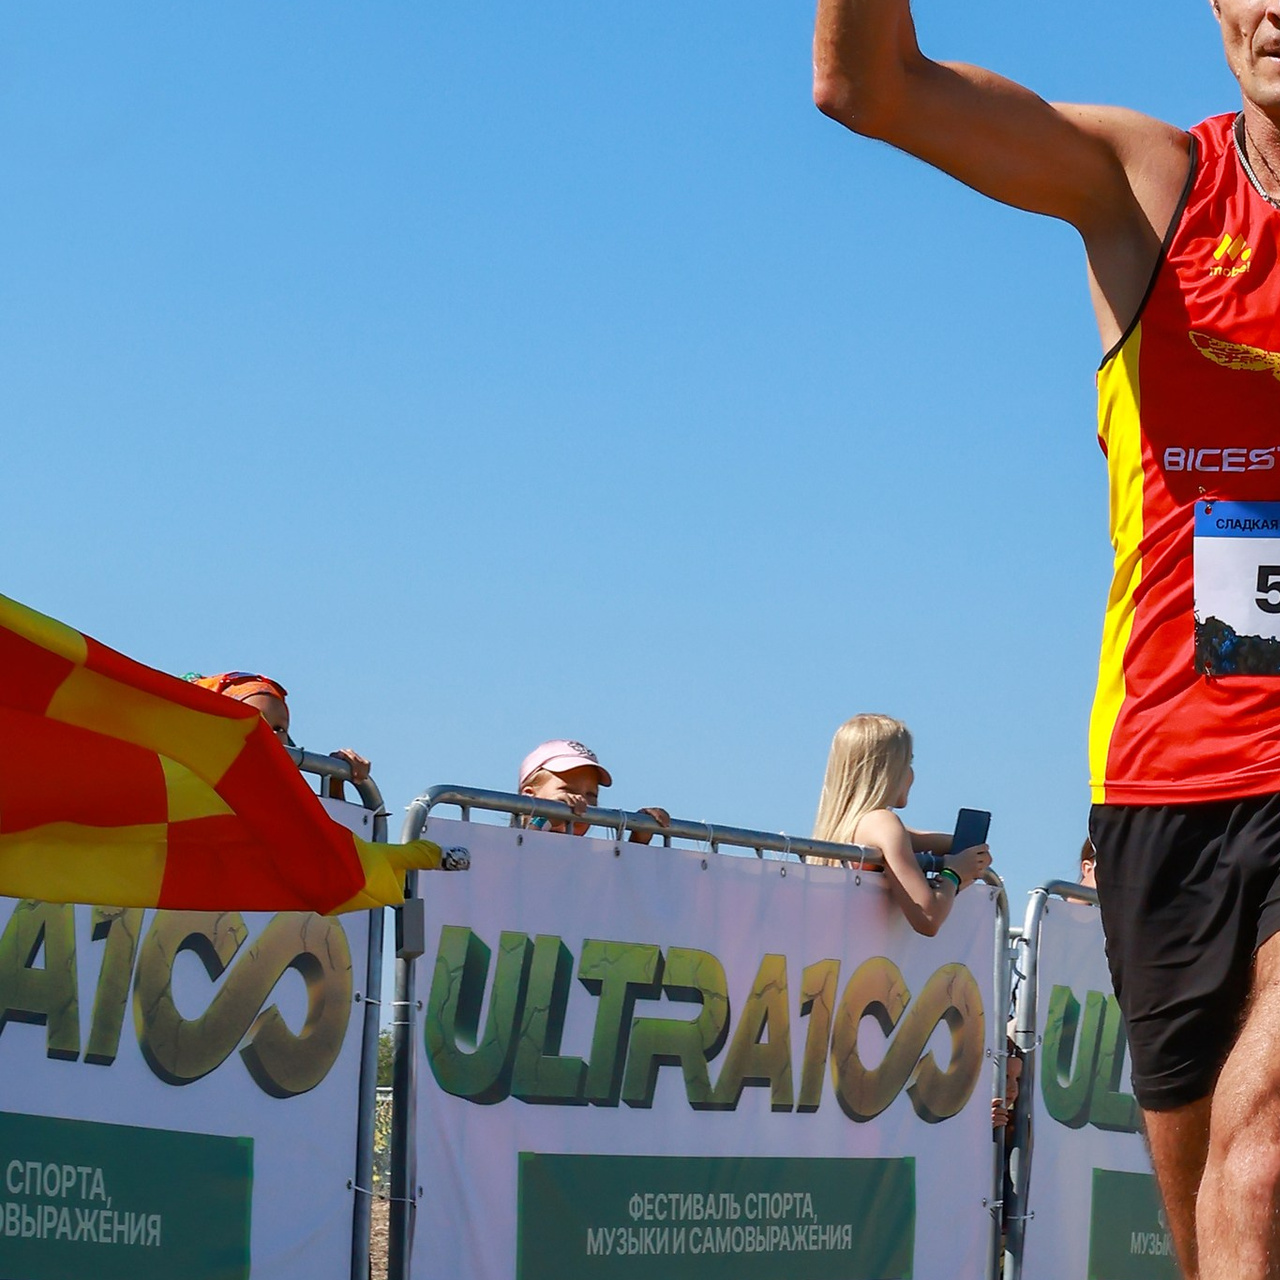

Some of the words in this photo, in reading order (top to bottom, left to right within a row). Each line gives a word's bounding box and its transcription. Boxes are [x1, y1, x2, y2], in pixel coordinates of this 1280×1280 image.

[1215, 518, 1278, 532] СЛАДКАЯ
[424, 924, 986, 1124] ULTRA100
[6, 1160, 113, 1209] СПОРТА,
[628, 1193, 741, 1221] ФЕСТИВАЛЬ
[745, 1192, 818, 1224] СПОРТА,
[586, 1227, 669, 1256] МУЗЫКИ
[672, 1227, 686, 1255] И
[689, 1224, 853, 1254] САМОВЫРАЖЕНИЯ
